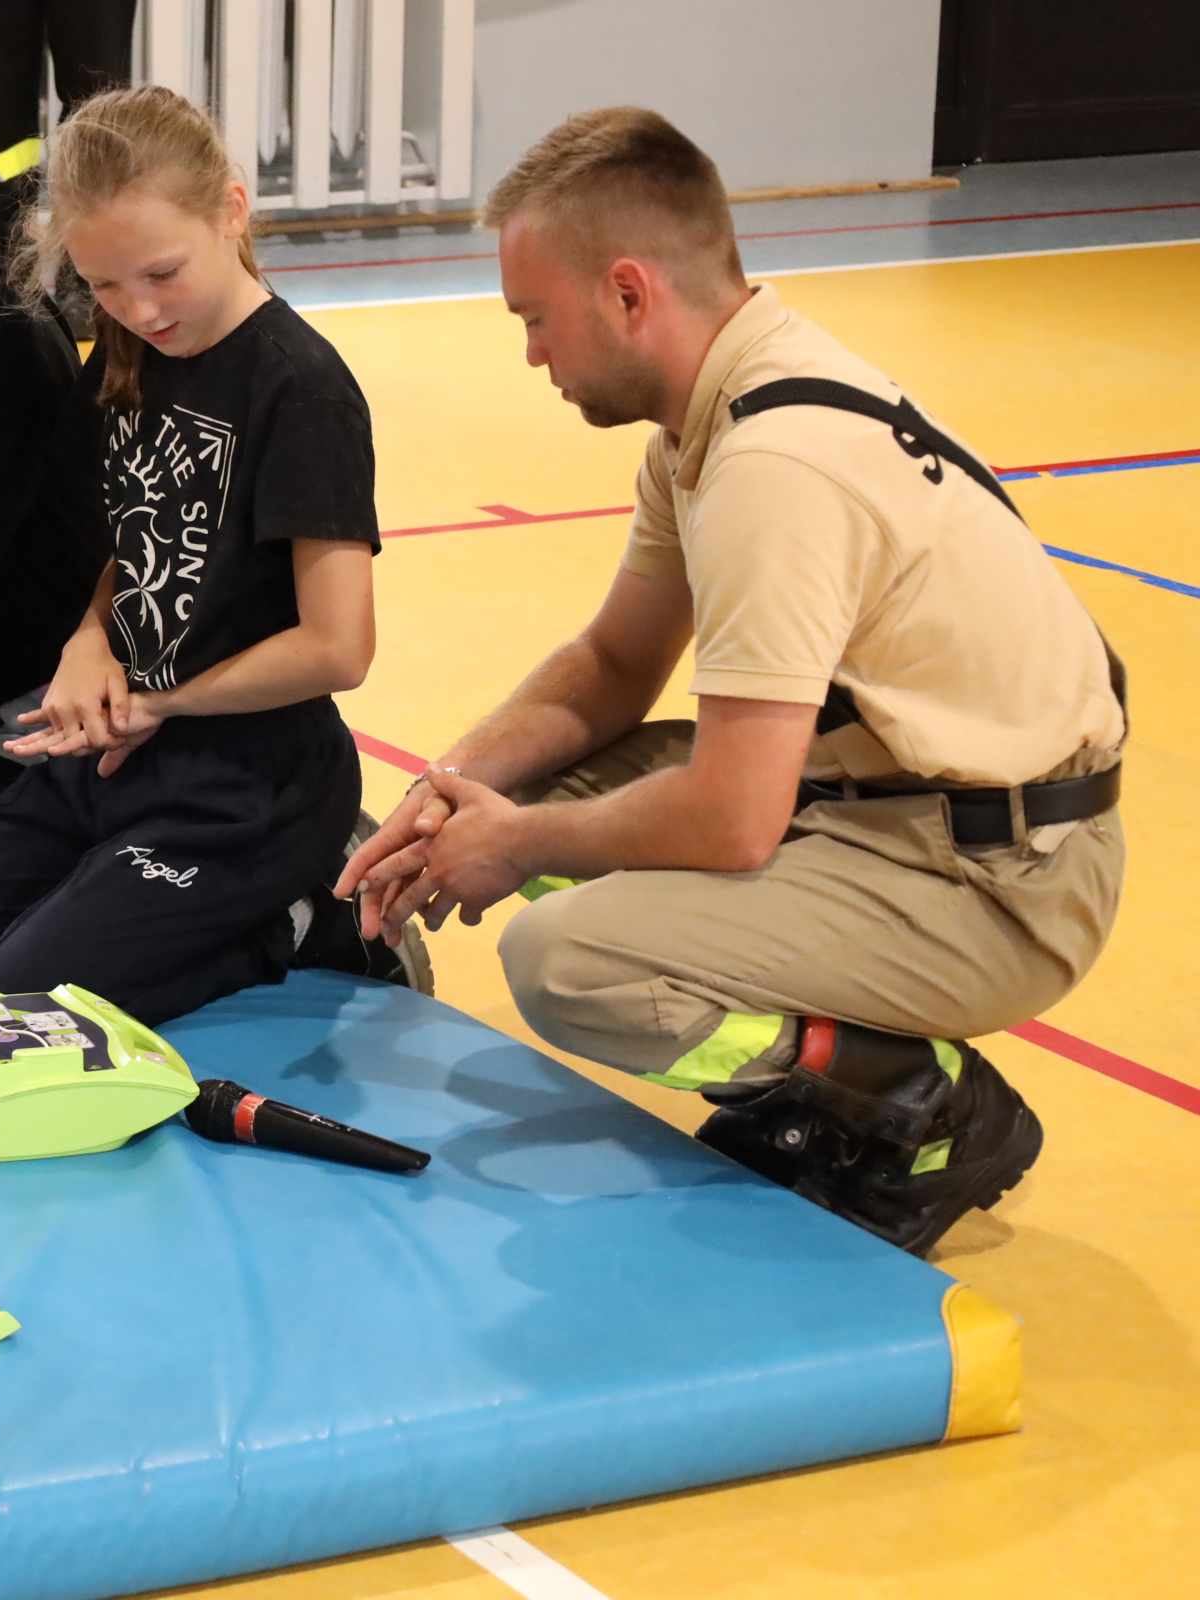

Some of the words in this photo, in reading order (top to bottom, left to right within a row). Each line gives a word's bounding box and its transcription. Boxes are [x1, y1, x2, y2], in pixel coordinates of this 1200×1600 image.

[155, 414, 196, 489] THE
[176, 501, 209, 584] SUN
[115, 846, 199, 888] Angel
